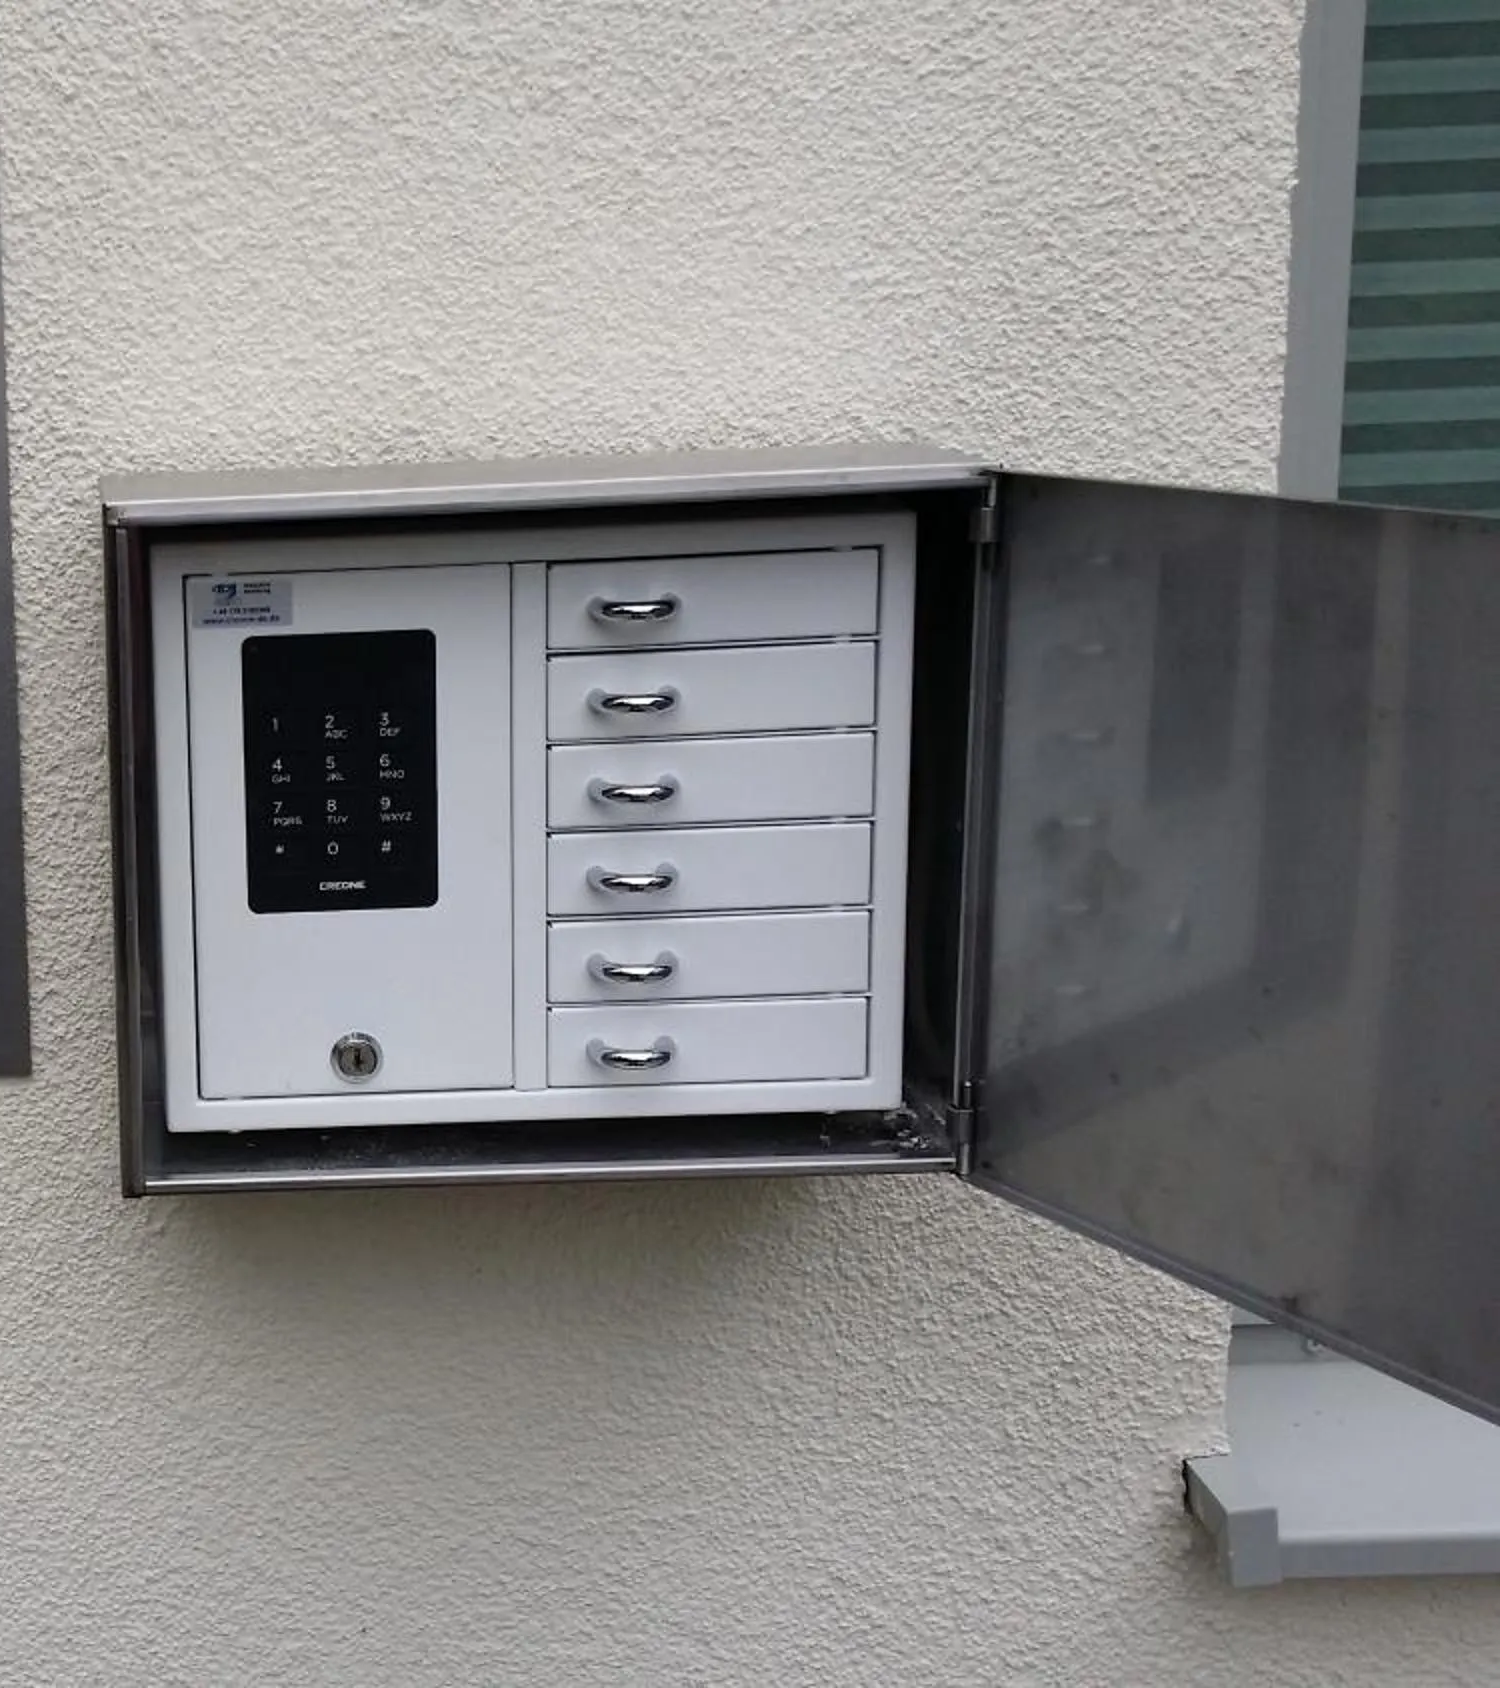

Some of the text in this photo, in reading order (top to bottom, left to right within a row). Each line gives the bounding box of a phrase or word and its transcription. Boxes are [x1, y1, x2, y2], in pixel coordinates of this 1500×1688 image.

[324, 729, 349, 739] ABC
[379, 727, 402, 737] DEF
[271, 774, 292, 784] GHI
[325, 772, 346, 782] JKL
[379, 769, 405, 780] MNO
[326, 814, 349, 825] TUV
[379, 812, 413, 823] WXYZ
